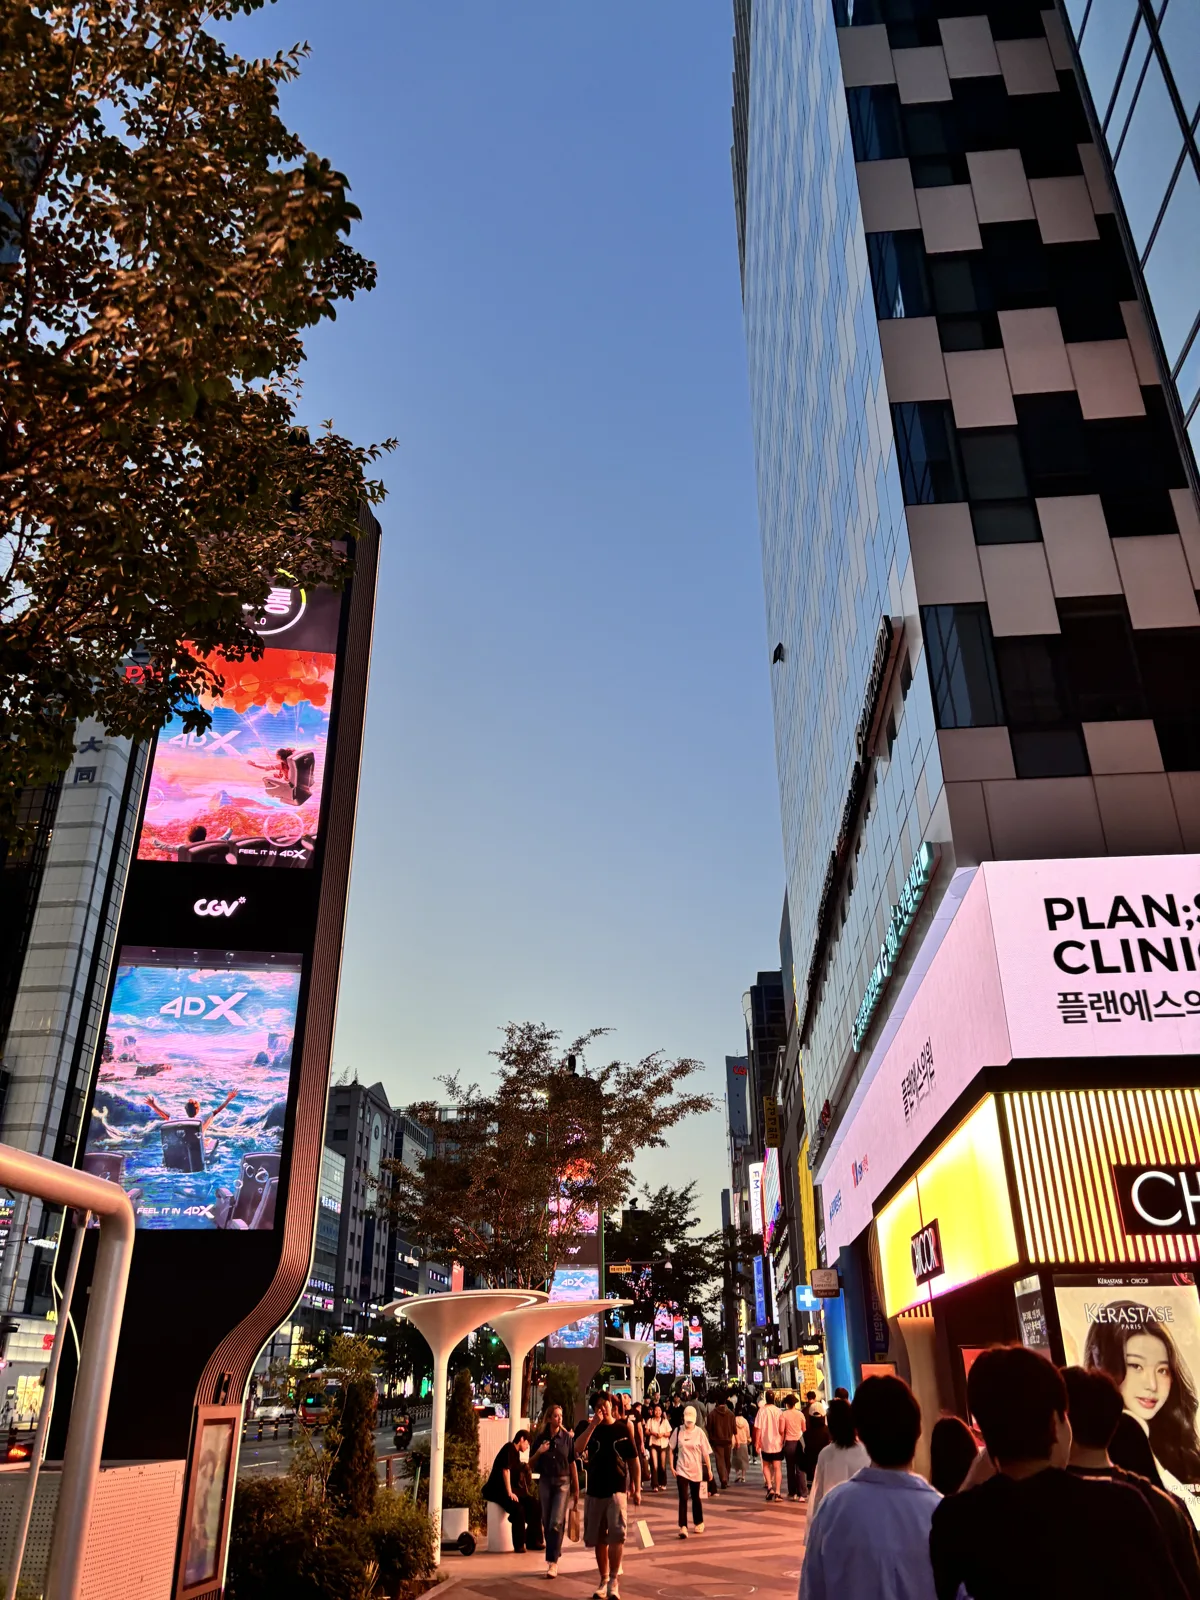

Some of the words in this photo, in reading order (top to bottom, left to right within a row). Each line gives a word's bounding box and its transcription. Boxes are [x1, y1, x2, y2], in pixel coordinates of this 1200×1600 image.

[168, 730, 242, 756] 4DX
[279, 849, 307, 860] 4DX
[193, 898, 242, 917] CGV
[1053, 937, 1200, 975] CLINI
[159, 991, 249, 1027] 4DX
[136, 1206, 159, 1215] FEEL
[161, 1207, 169, 1215] IT
[171, 1207, 181, 1215] IN
[183, 1204, 215, 1219] 4DX
[561, 1276, 586, 1288] 4DX
[1084, 1302, 1175, 1324] KÉRASTASE
